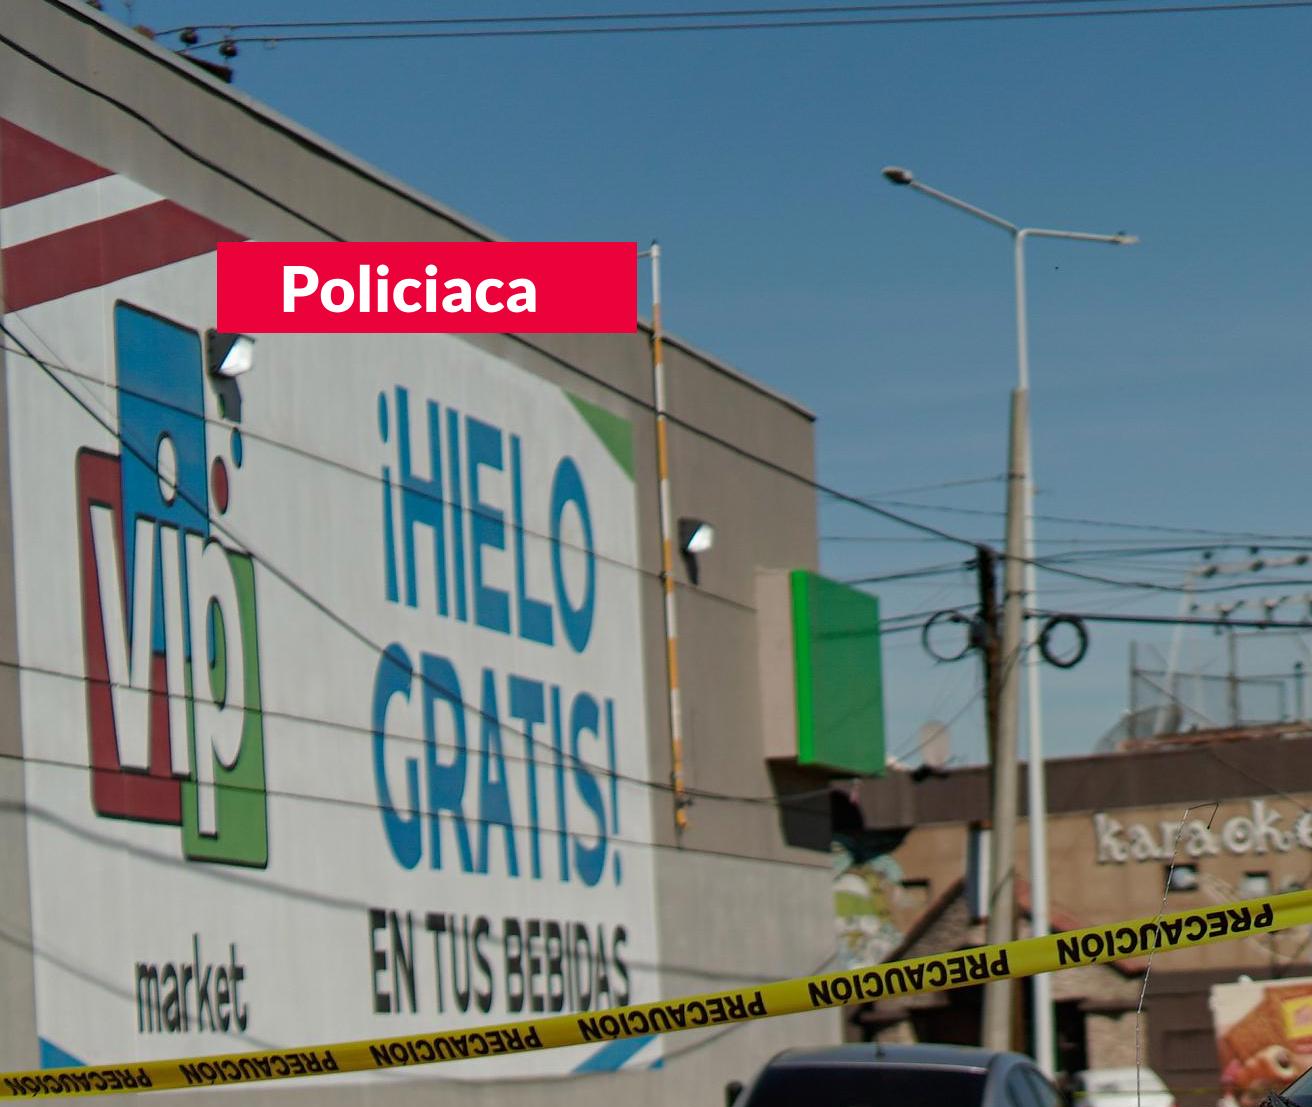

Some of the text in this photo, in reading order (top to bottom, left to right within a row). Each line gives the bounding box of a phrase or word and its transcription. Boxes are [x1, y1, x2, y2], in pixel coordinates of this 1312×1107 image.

[378, 385, 597, 653] ¡HIELO
[371, 643, 623, 887] GRATIS!
[135, 933, 248, 1033] market
[369, 908, 630, 1015] EN TUS BEBIDAS
